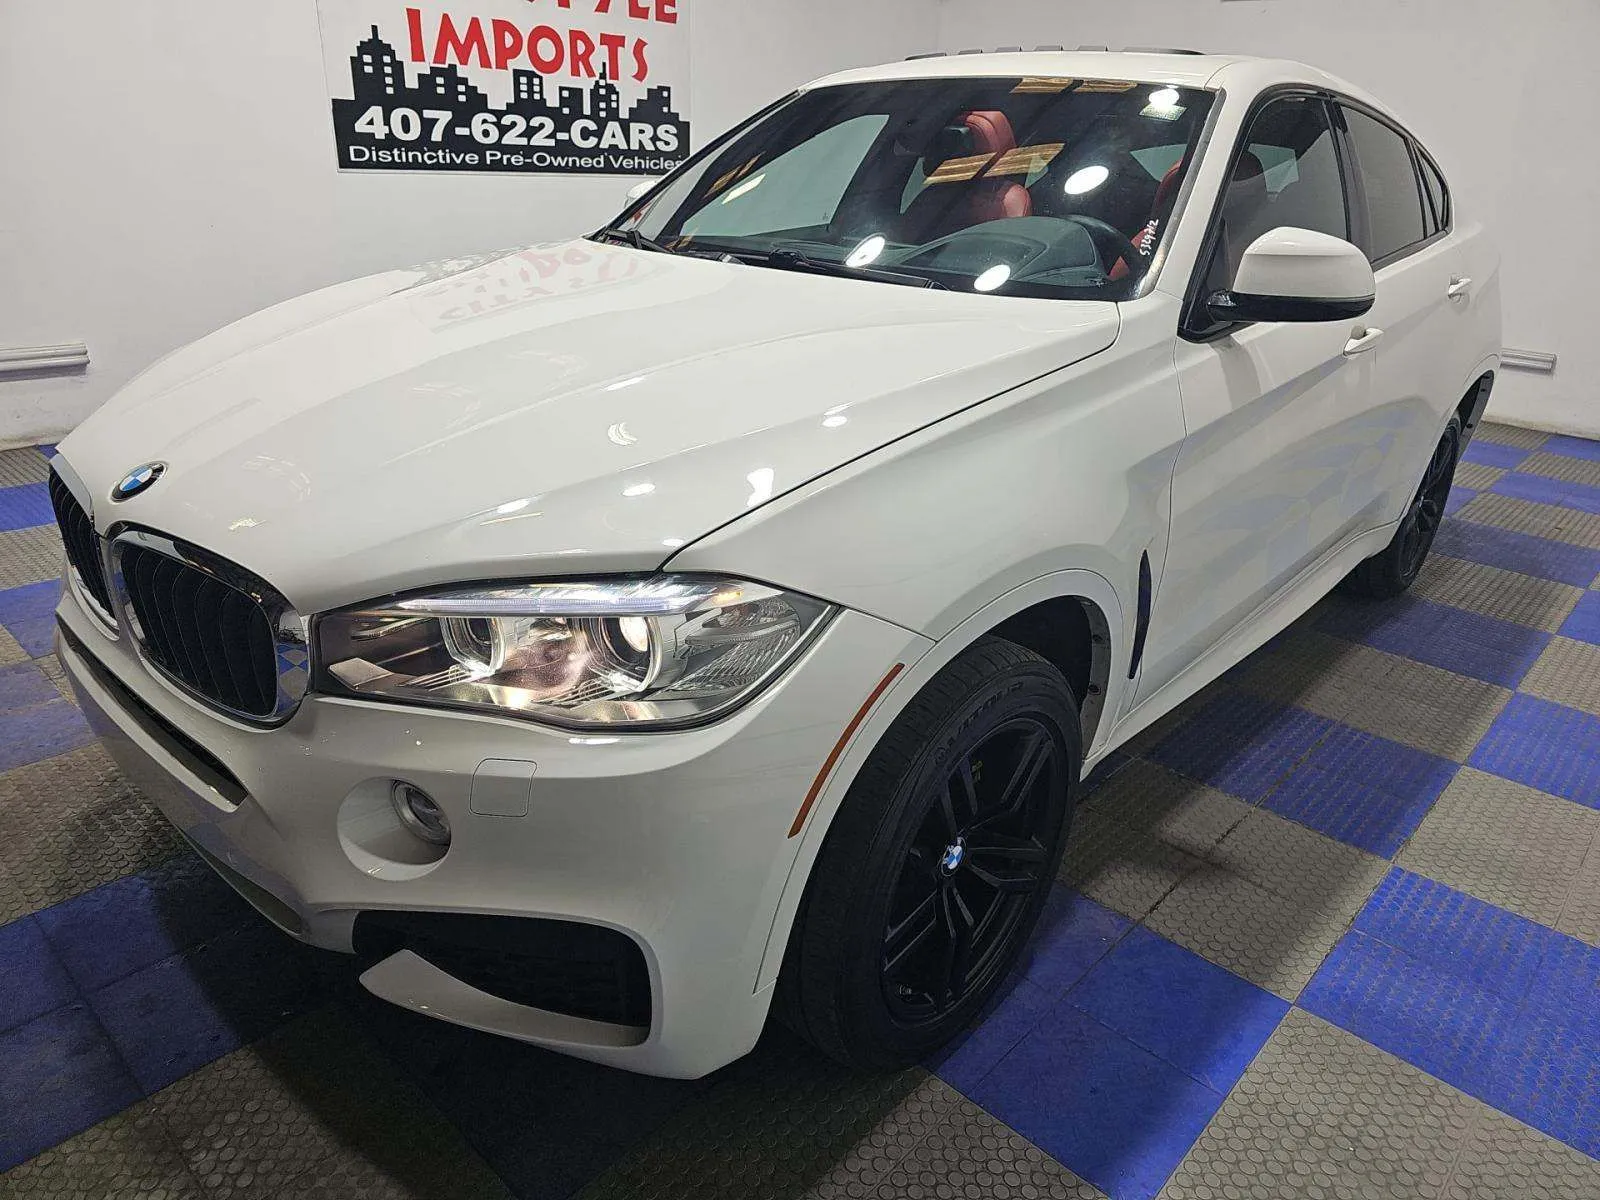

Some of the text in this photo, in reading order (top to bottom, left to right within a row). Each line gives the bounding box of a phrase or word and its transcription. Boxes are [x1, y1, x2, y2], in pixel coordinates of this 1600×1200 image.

[406, 8, 649, 82] IMPORTS
[354, 105, 679, 152] 407-622-CARS
[349, 145, 479, 165] Distinctive
[485, 150, 604, 168] Pre-Owned
